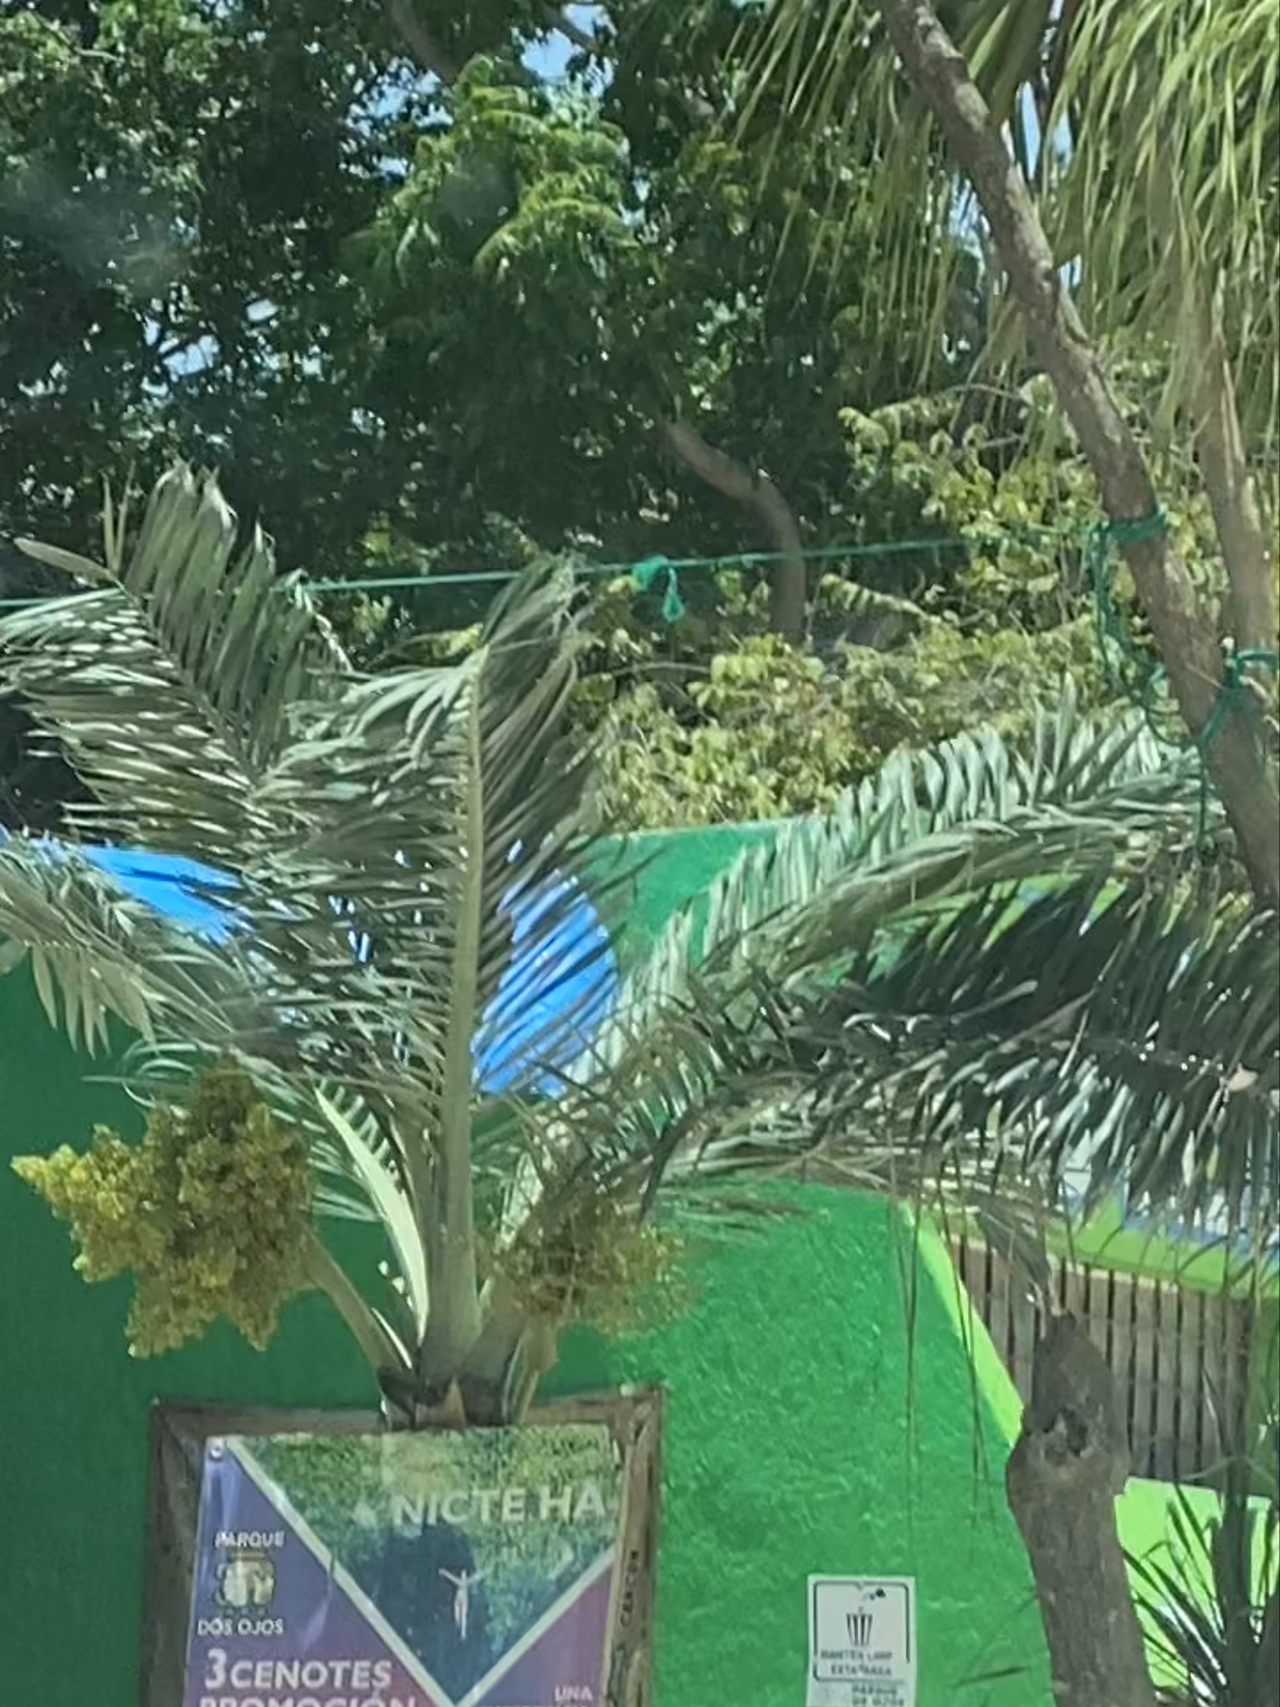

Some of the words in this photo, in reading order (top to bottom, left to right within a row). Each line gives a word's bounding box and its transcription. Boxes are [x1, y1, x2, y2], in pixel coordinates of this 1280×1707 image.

[394, 1487, 526, 1526] NICTE
[214, 1530, 285, 1548] PARQUE
[197, 1619, 233, 1636] DOS
[237, 1618, 284, 1636] OJOS
[204, 1648, 228, 1690] 3
[230, 1659, 393, 1690] CENOTES
[554, 1685, 593, 1703] UNA
